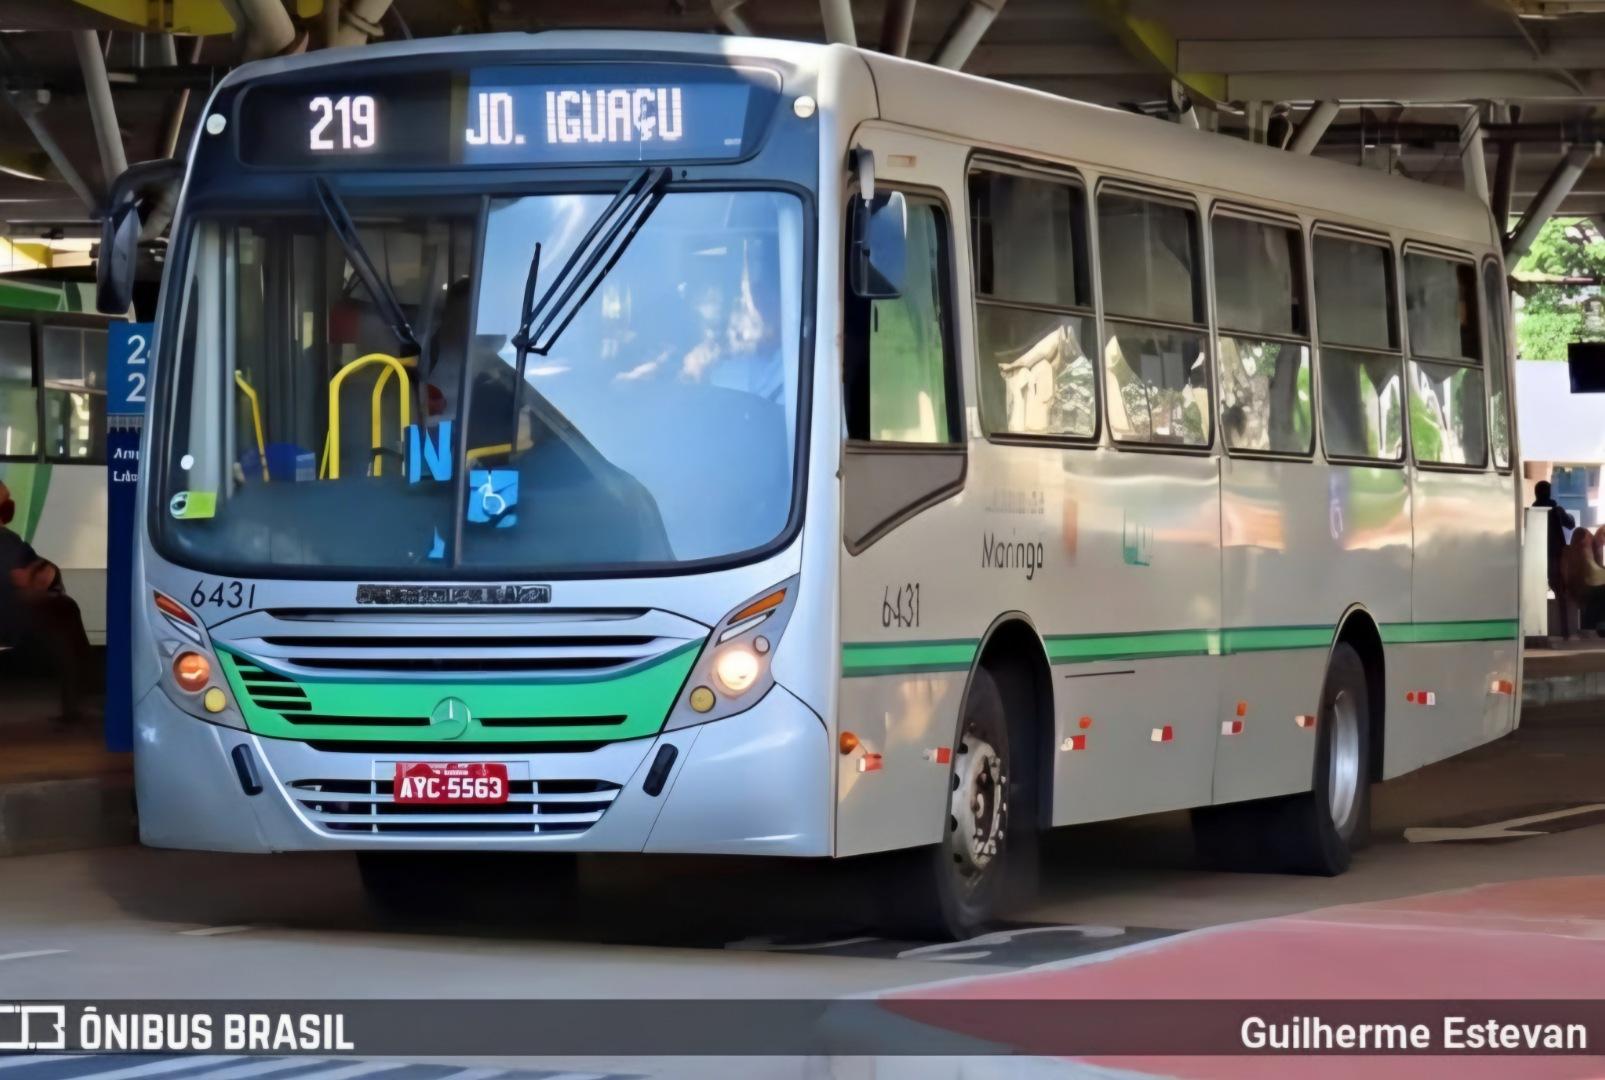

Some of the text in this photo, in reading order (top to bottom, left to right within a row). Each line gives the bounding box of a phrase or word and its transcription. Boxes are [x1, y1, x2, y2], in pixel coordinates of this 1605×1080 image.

[309, 95, 376, 151] 219
[466, 87, 683, 145] JD. IGUAÇU
[190, 580, 256, 609] 6431
[881, 582, 921, 628] 6431
